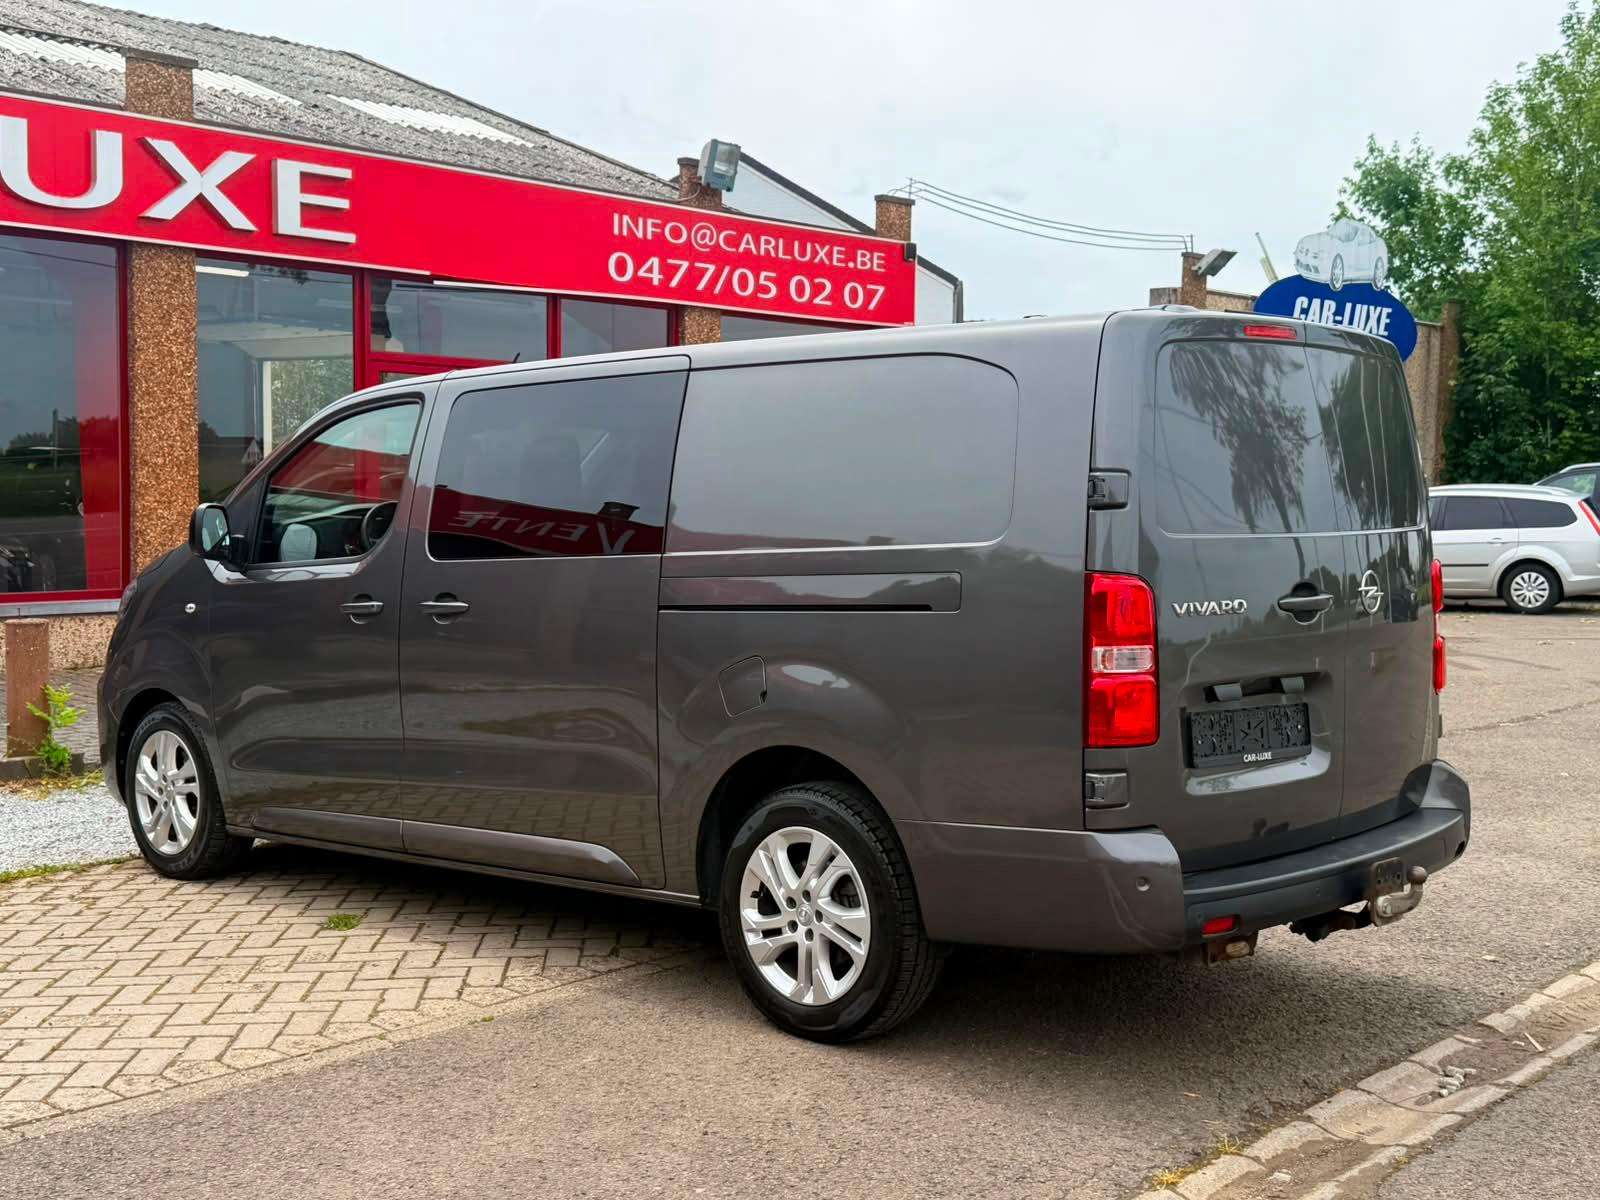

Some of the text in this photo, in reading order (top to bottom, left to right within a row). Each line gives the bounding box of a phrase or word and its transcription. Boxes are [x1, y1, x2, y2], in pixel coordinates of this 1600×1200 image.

[0, 115, 357, 244] UXE
[612, 212, 886, 272] INFO@CARLUXE.BE
[608, 251, 885, 311] 0477/05 02 07
[1293, 296, 1392, 336] CAR-LUXE
[1171, 599, 1247, 617] VIVARO
[1243, 751, 1272, 762] CAR-LUXE
